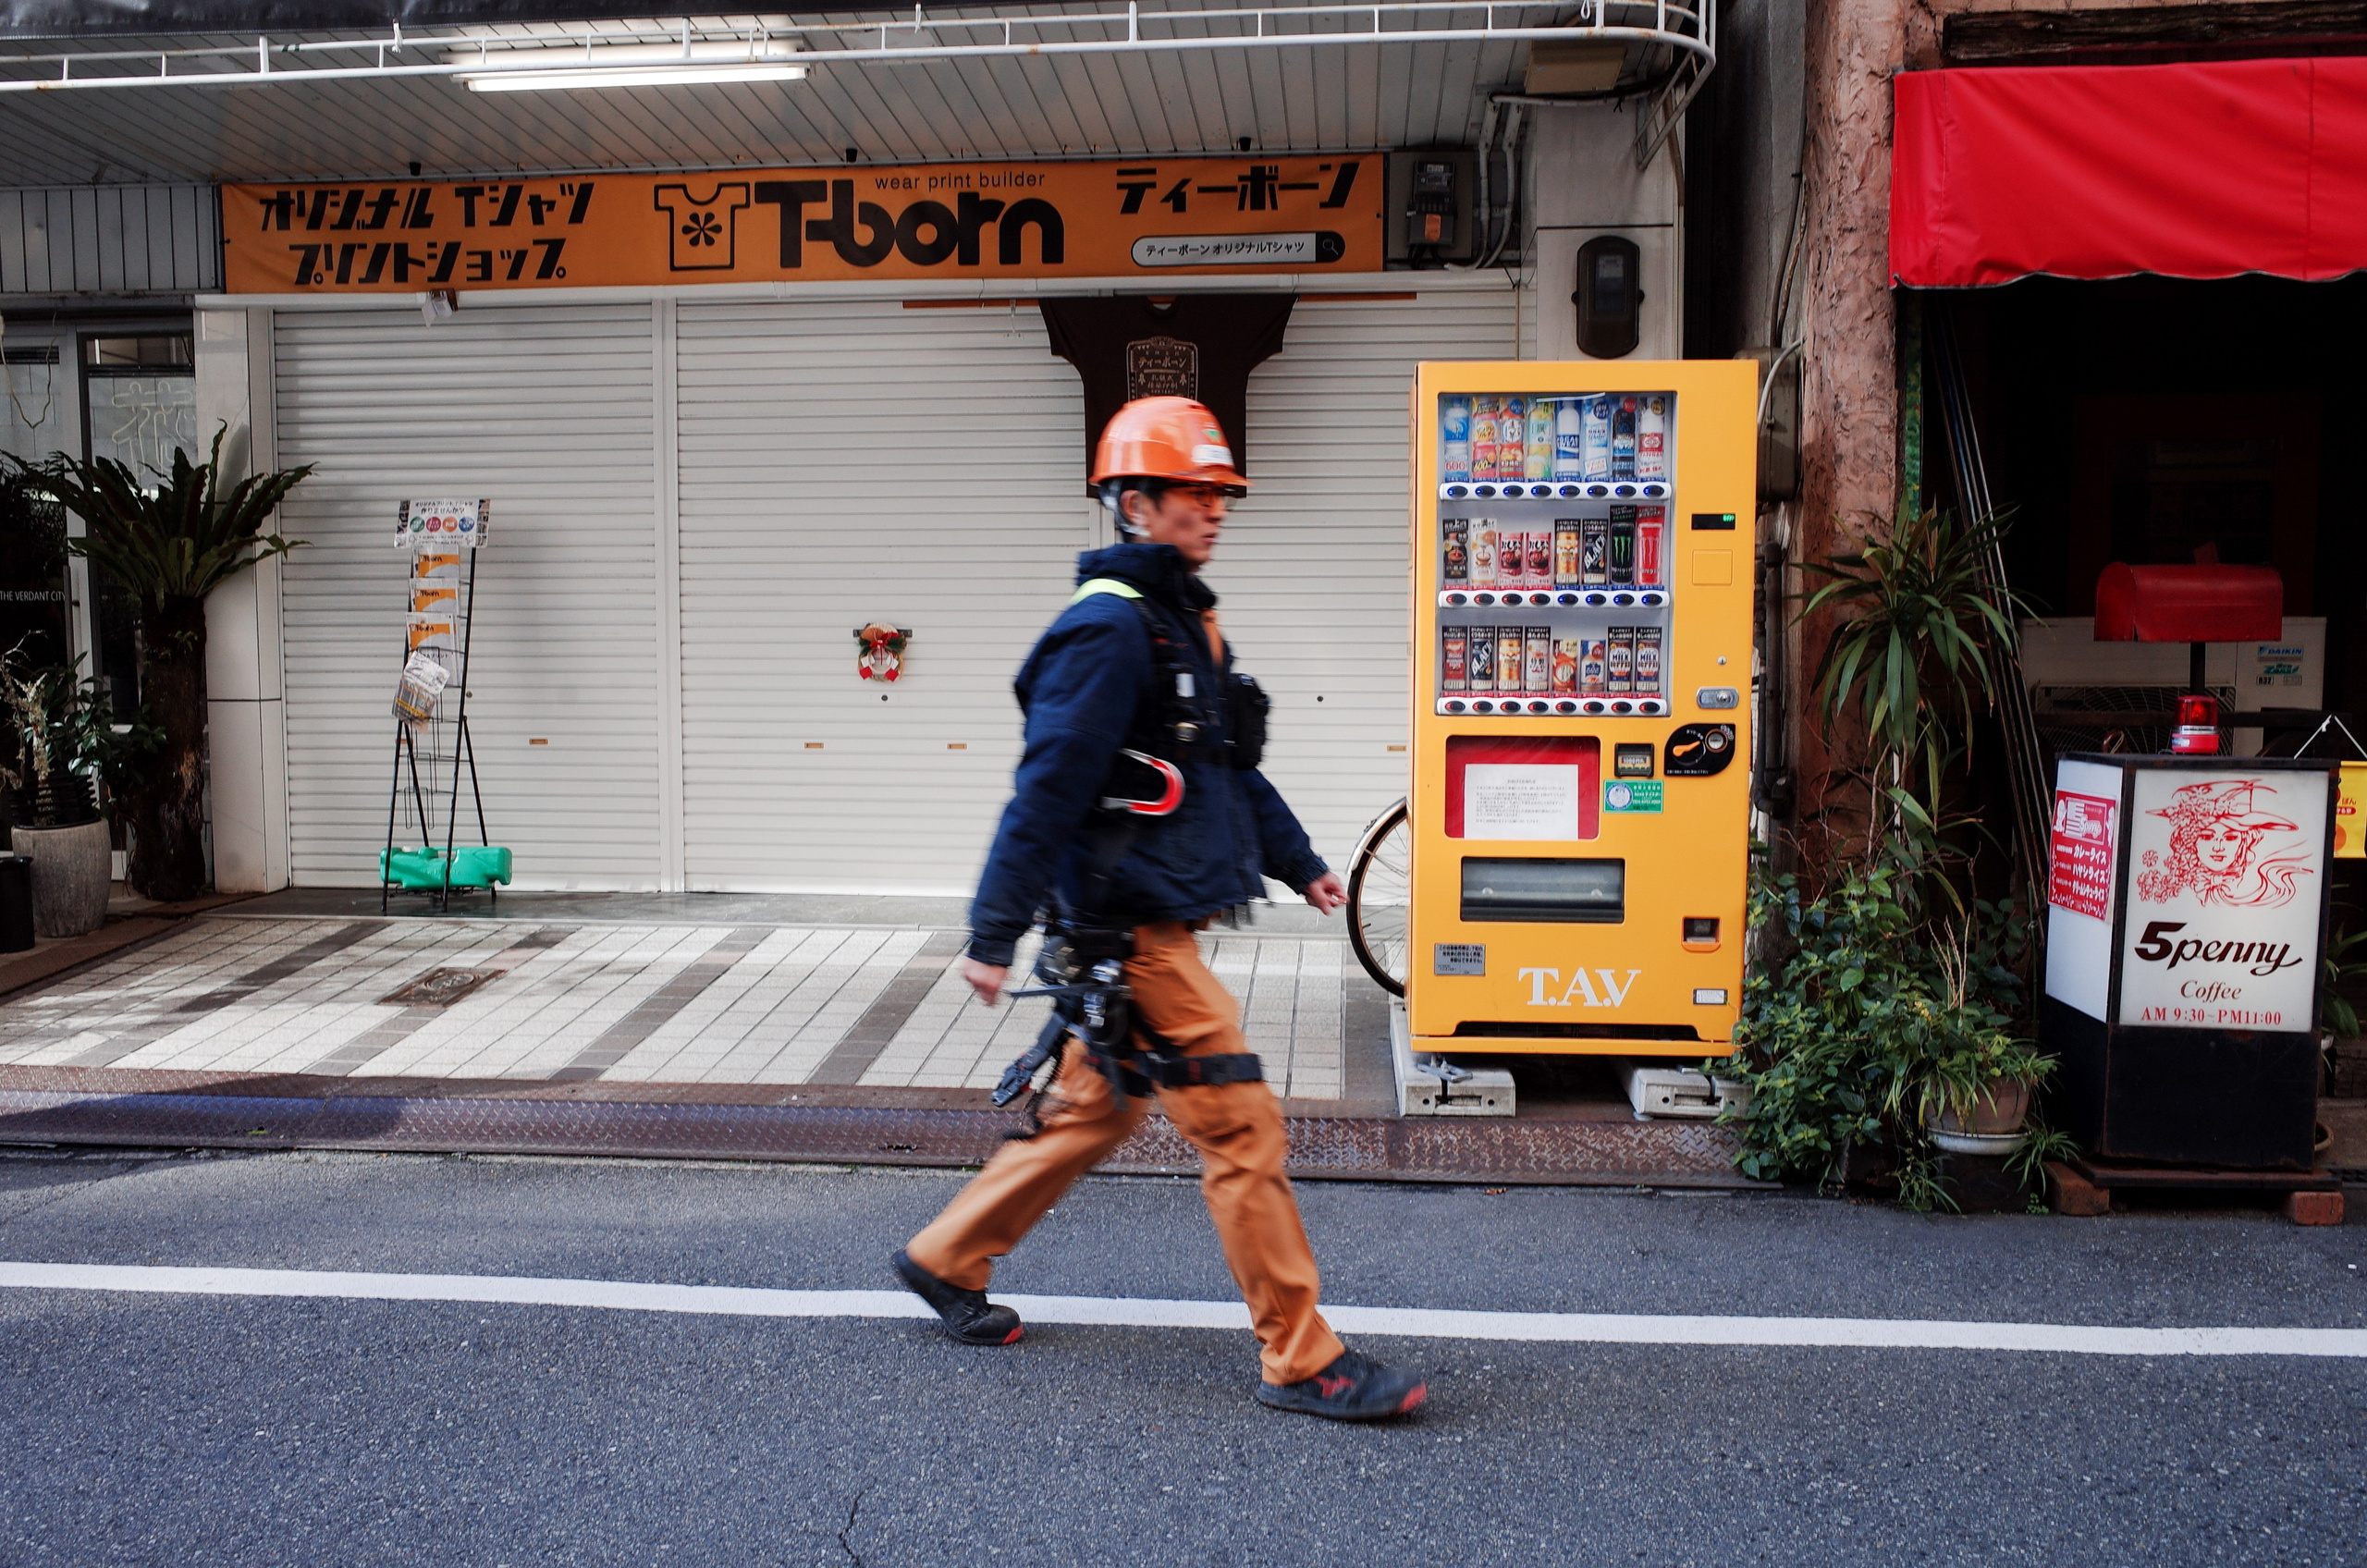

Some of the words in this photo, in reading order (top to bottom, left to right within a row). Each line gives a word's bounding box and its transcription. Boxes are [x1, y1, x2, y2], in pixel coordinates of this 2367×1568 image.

[875, 176, 920, 190] wear
[928, 173, 971, 190] print
[979, 171, 1045, 188] builder
[1115, 163, 1360, 214] ティーボーン
[259, 187, 435, 231] オリジナル
[455, 181, 595, 227] Tシャツ
[1146, 244, 1210, 257] ティーボーン
[1212, 241, 1305, 256] オリジナルTシャツ
[289, 238, 567, 286] プリントショップ
[1445, 461, 1466, 471] 600
[1583, 533, 1606, 570] BLACK
[0, 590, 14, 602] THE
[14, 590, 49, 602] VERDANT
[50, 590, 66, 602] CITY
[1471, 639, 1493, 676] BLACK
[2073, 843, 2107, 865] カレーライス
[2072, 863, 2105, 884] ハヤシライス
[2134, 921, 2303, 976] 5penny
[2180, 980, 2242, 1003] Coffee
[2140, 1007, 2167, 1022] AM
